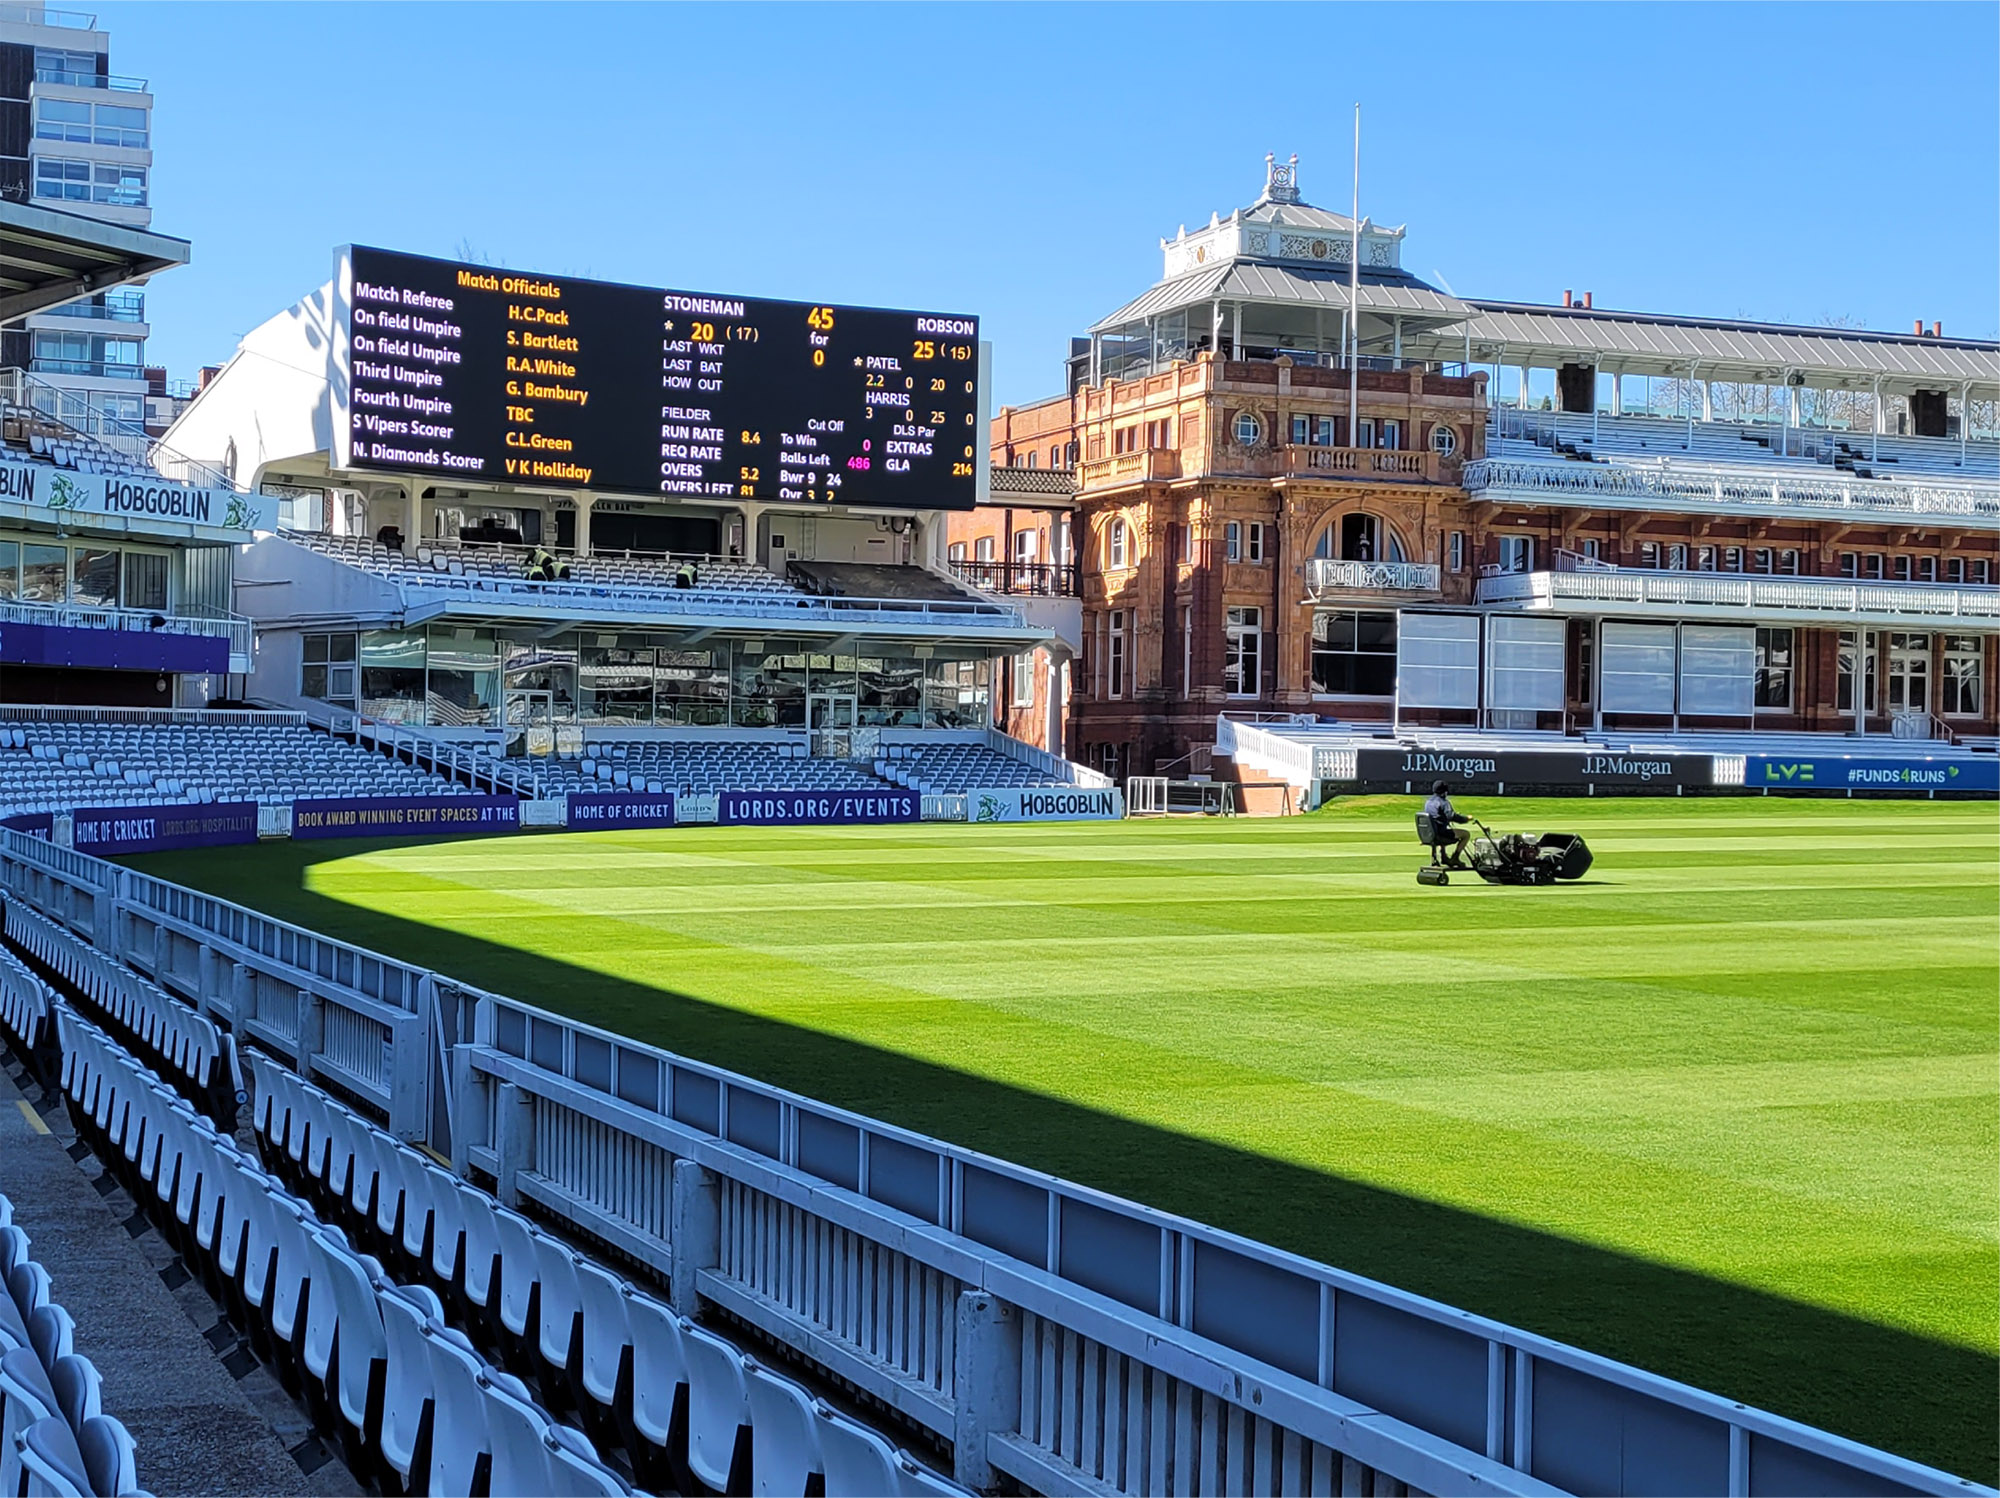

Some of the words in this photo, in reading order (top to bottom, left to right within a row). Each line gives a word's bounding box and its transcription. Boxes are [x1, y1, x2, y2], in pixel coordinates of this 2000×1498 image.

[458, 270, 499, 291] Match
[502, 278, 560, 298] Officials
[356, 282, 399, 303] Match
[403, 289, 454, 311] Referee
[664, 295, 744, 317] STONEMAN
[354, 308, 375, 325] On
[378, 311, 409, 330] field
[413, 316, 461, 339] Umpire
[509, 305, 569, 325] H.C.Pack
[808, 307, 834, 330] 45
[691, 322, 714, 341] 20
[917, 318, 974, 335] ROBSON
[507, 330, 519, 345] S.
[523, 332, 578, 352] Bartlett
[663, 339, 693, 352] LAST
[698, 342, 725, 355] WKT
[810, 331, 829, 346] for
[354, 335, 375, 352] On
[378, 337, 409, 356] field
[412, 342, 461, 365] Umpire
[814, 350, 824, 366] 0
[913, 341, 934, 359] 25
[507, 356, 576, 377] R.A.White
[663, 358, 693, 371] LAST
[700, 361, 723, 374] BAT
[866, 356, 902, 371] PATEL
[353, 361, 390, 380] Third
[394, 366, 443, 388] Umpire
[663, 375, 692, 389] HOW
[698, 378, 723, 391] OUT
[866, 374, 884, 387] 2.2
[906, 377, 913, 389] 0
[931, 378, 945, 391] 20
[965, 381, 973, 393] 0
[354, 388, 400, 408] Fourth
[403, 394, 452, 416] Umpire
[506, 381, 521, 395] G.
[525, 382, 588, 406] Bambury
[866, 391, 910, 406] HARRIS
[506, 406, 534, 422] TBC
[662, 406, 711, 421] FIELDER
[866, 407, 873, 419] 3
[906, 409, 913, 422] 0
[931, 411, 945, 424] 25
[966, 413, 973, 425] 0
[353, 413, 362, 428] S
[364, 414, 408, 435] Vipers
[410, 420, 454, 439] Scorer
[662, 425, 689, 439] RUN
[692, 427, 724, 442] RATE
[741, 430, 761, 444] 8.4
[808, 418, 826, 431] Cut
[828, 420, 844, 432] Off
[893, 424, 916, 436] DLS
[917, 426, 936, 438] Par
[506, 432, 572, 451] C.L.Green
[781, 433, 794, 445] To
[795, 434, 817, 446] Win
[863, 439, 871, 451] 0
[886, 440, 933, 456] EXTRAS
[964, 445, 973, 458] 0
[353, 441, 368, 457] N.
[372, 443, 440, 465] Diamonds
[442, 451, 484, 470] Scorer
[662, 444, 687, 459] REQ
[690, 446, 721, 460] RATE
[780, 452, 807, 464] Balls
[808, 454, 830, 466] Left
[847, 456, 870, 470] 486
[505, 459, 516, 473] V
[519, 460, 530, 475] K
[533, 461, 592, 483] Holliday
[661, 462, 702, 477] OVERS
[741, 467, 759, 480] 5.2
[886, 458, 910, 472] GLA
[952, 462, 973, 476] 214
[780, 470, 805, 484] Bwr
[807, 472, 816, 484] 9
[826, 473, 842, 486] 24
[105, 480, 210, 521] HOBGOBLIN
[1402, 754, 1496, 778] J.P.Morgan
[1582, 757, 1672, 781] J.P.Morgan
[1848, 767, 1945, 783] #FUNDS4RUNS
[575, 805, 604, 819] HOME
[608, 805, 621, 818] OF
[625, 804, 668, 818] CRICKET
[729, 798, 911, 819] LORDS.ORG/EVENTS
[1020, 792, 1113, 817] HOBGOBLIN
[298, 812, 323, 827] BOOK
[326, 811, 356, 826] AWARD
[358, 809, 403, 824] WINNING
[407, 808, 438, 823] EVENT
[440, 808, 478, 822] SPACES
[481, 807, 493, 821] AT
[496, 807, 515, 820] THE
[76, 822, 98, 843] HOME
[100, 821, 112, 840] OF
[114, 818, 156, 840] CRICKET
